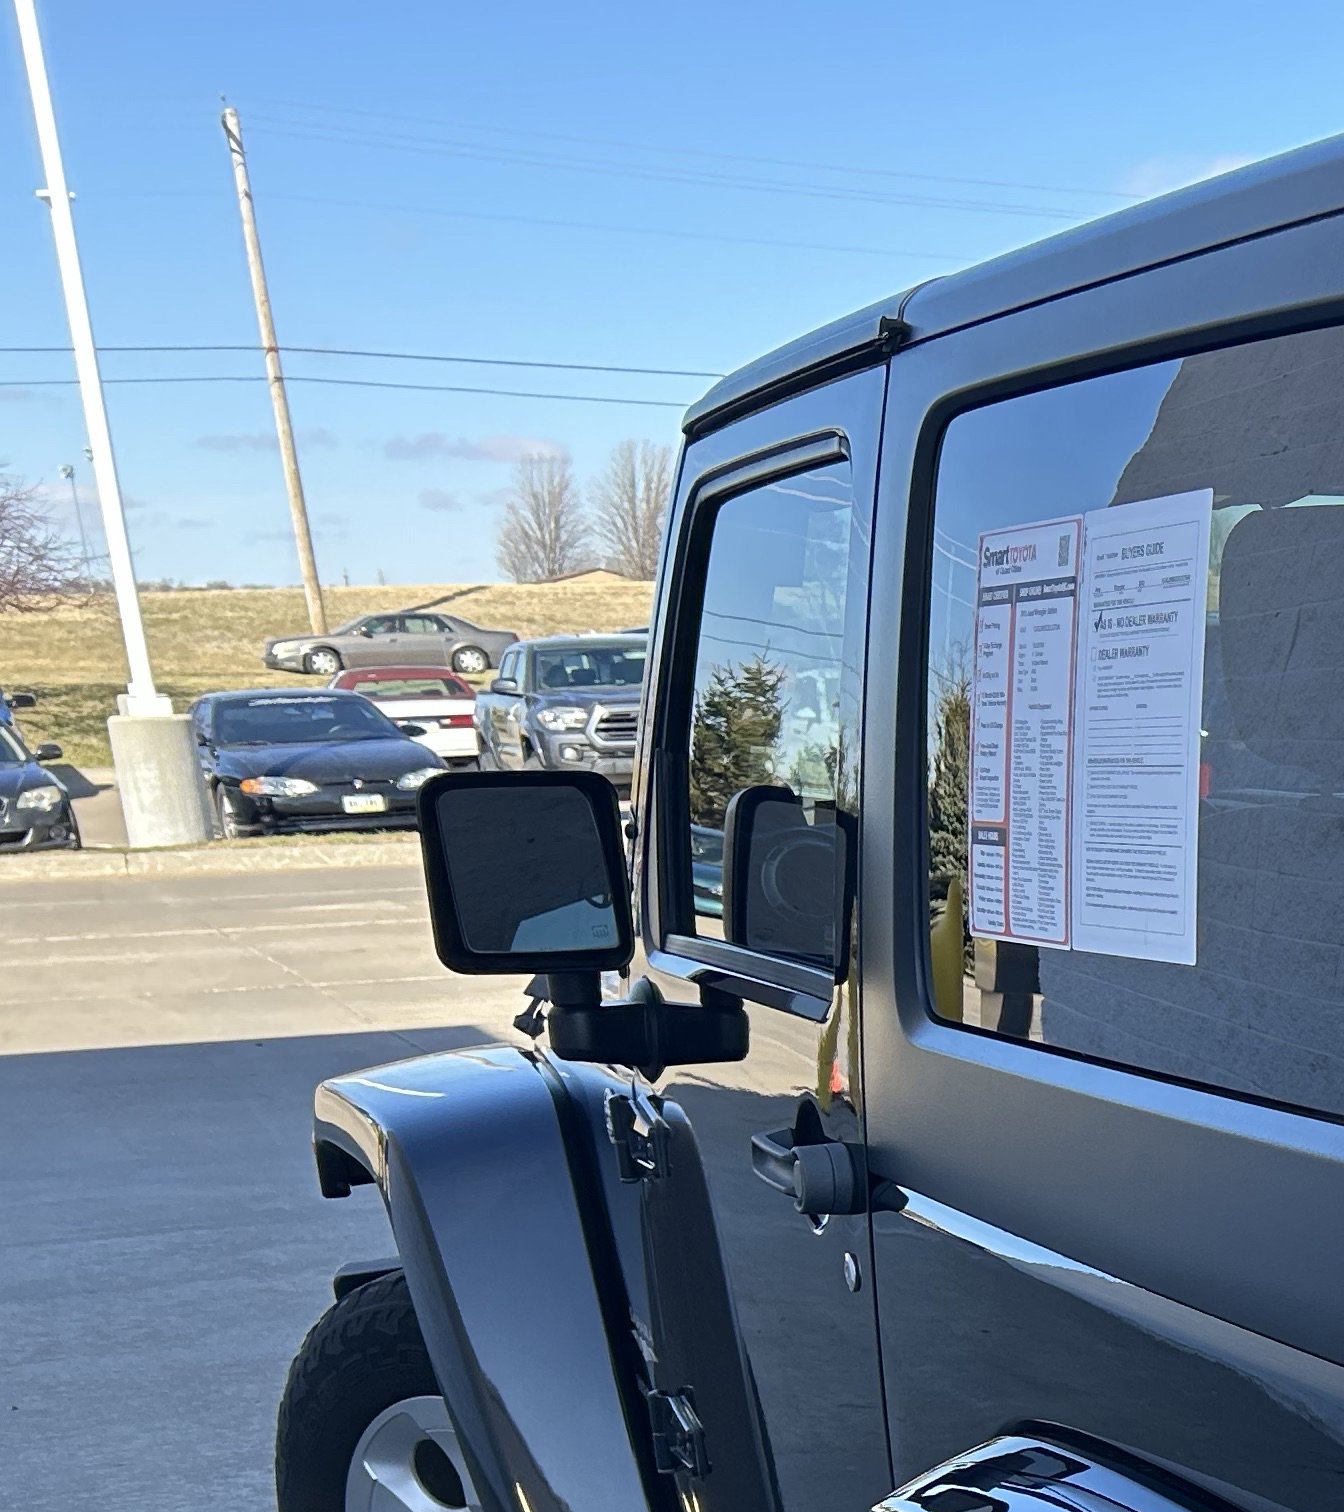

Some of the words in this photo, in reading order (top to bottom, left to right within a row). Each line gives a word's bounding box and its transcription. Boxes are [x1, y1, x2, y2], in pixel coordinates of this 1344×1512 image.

[983, 545, 1009, 568] Smart
[1010, 544, 1036, 563] TOYOTA
[1121, 545, 1145, 560] BUYERS
[1146, 541, 1164, 556] GUIDE
[1125, 614, 1146, 627] DEALER
[1148, 611, 1178, 624] WARRANTY
[1098, 648, 1118, 660] DEALER
[1120, 645, 1149, 658] WARRANTY
